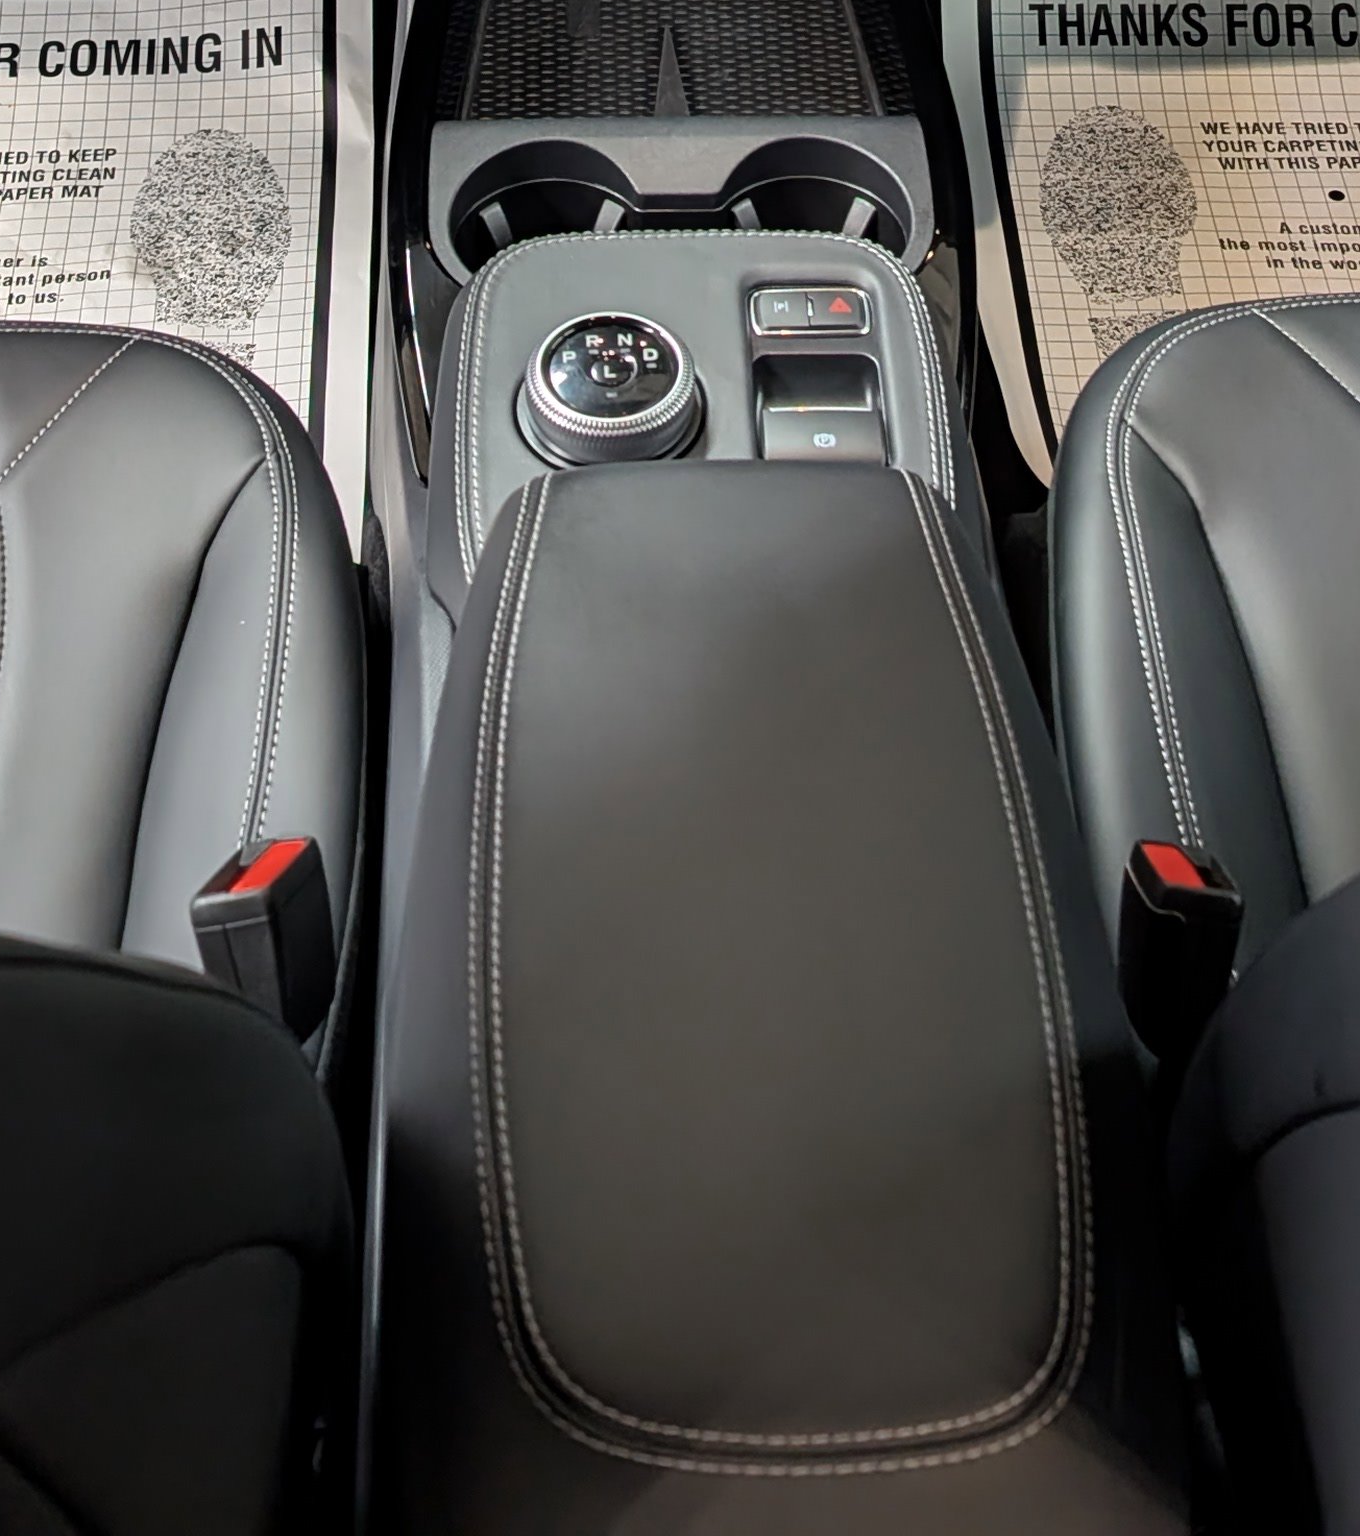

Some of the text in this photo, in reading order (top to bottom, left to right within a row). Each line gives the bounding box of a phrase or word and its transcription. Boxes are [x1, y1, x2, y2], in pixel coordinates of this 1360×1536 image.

[1028, 2, 1209, 48] THANKS
[1225, 2, 1315, 48] FOR
[38, 32, 222, 77] COMING
[240, 25, 283, 70] IN
[1200, 121, 1232, 135] WE
[1239, 121, 1287, 135] HAVE
[1291, 121, 1349, 135] TRIED
[1202, 139, 1258, 153] YOUR
[36, 149, 61, 165] TO
[68, 148, 118, 163] KEEP
[1218, 156, 1270, 170] WITH
[1274, 156, 1320, 170] THIS
[52, 167, 117, 181] CLEAN
[61, 185, 104, 199] MAT
[1279, 221, 1293, 235] A
[1218, 237, 1250, 251] the
[1258, 239, 1307, 252] most
[31, 255, 48, 268] is
[1265, 255, 1284, 268] in
[1291, 256, 1323, 270] the
[41, 269, 112, 288] person
[7, 292, 26, 305] to
[34, 291, 65, 304] us.
[585, 333, 633, 348] R N
[562, 350, 577, 364] P
[642, 347, 659, 362] D
[603, 365, 617, 379] L
